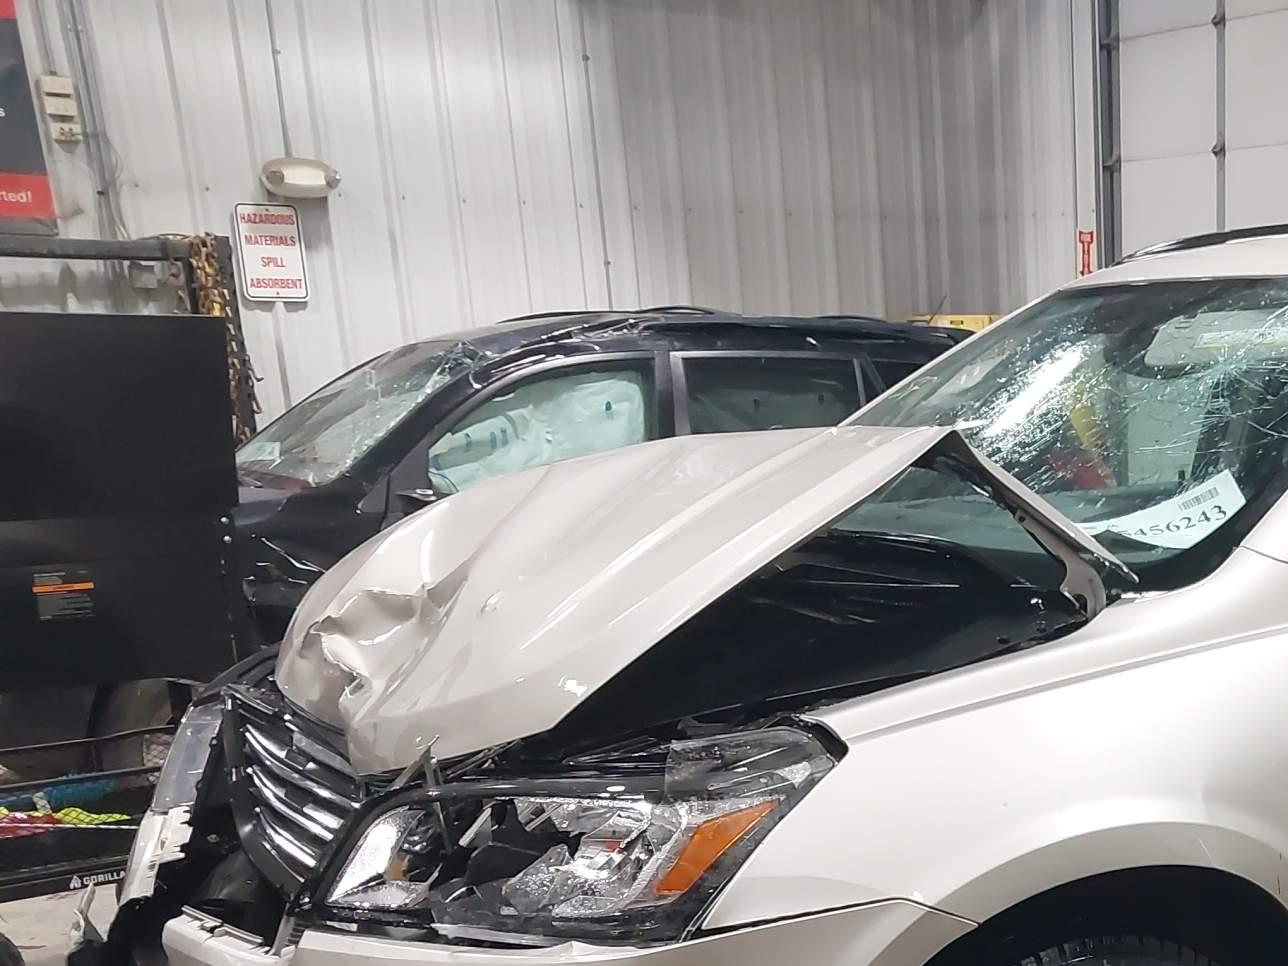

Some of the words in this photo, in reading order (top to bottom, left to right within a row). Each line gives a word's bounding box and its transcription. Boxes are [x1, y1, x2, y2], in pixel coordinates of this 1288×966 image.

[240, 212, 296, 226] HAZARDOUS
[244, 234, 297, 247] MATERIALS
[260, 256, 287, 268] SPILL
[249, 277, 303, 290] ABSORBENT
[82, 870, 126, 885] GORILLA
